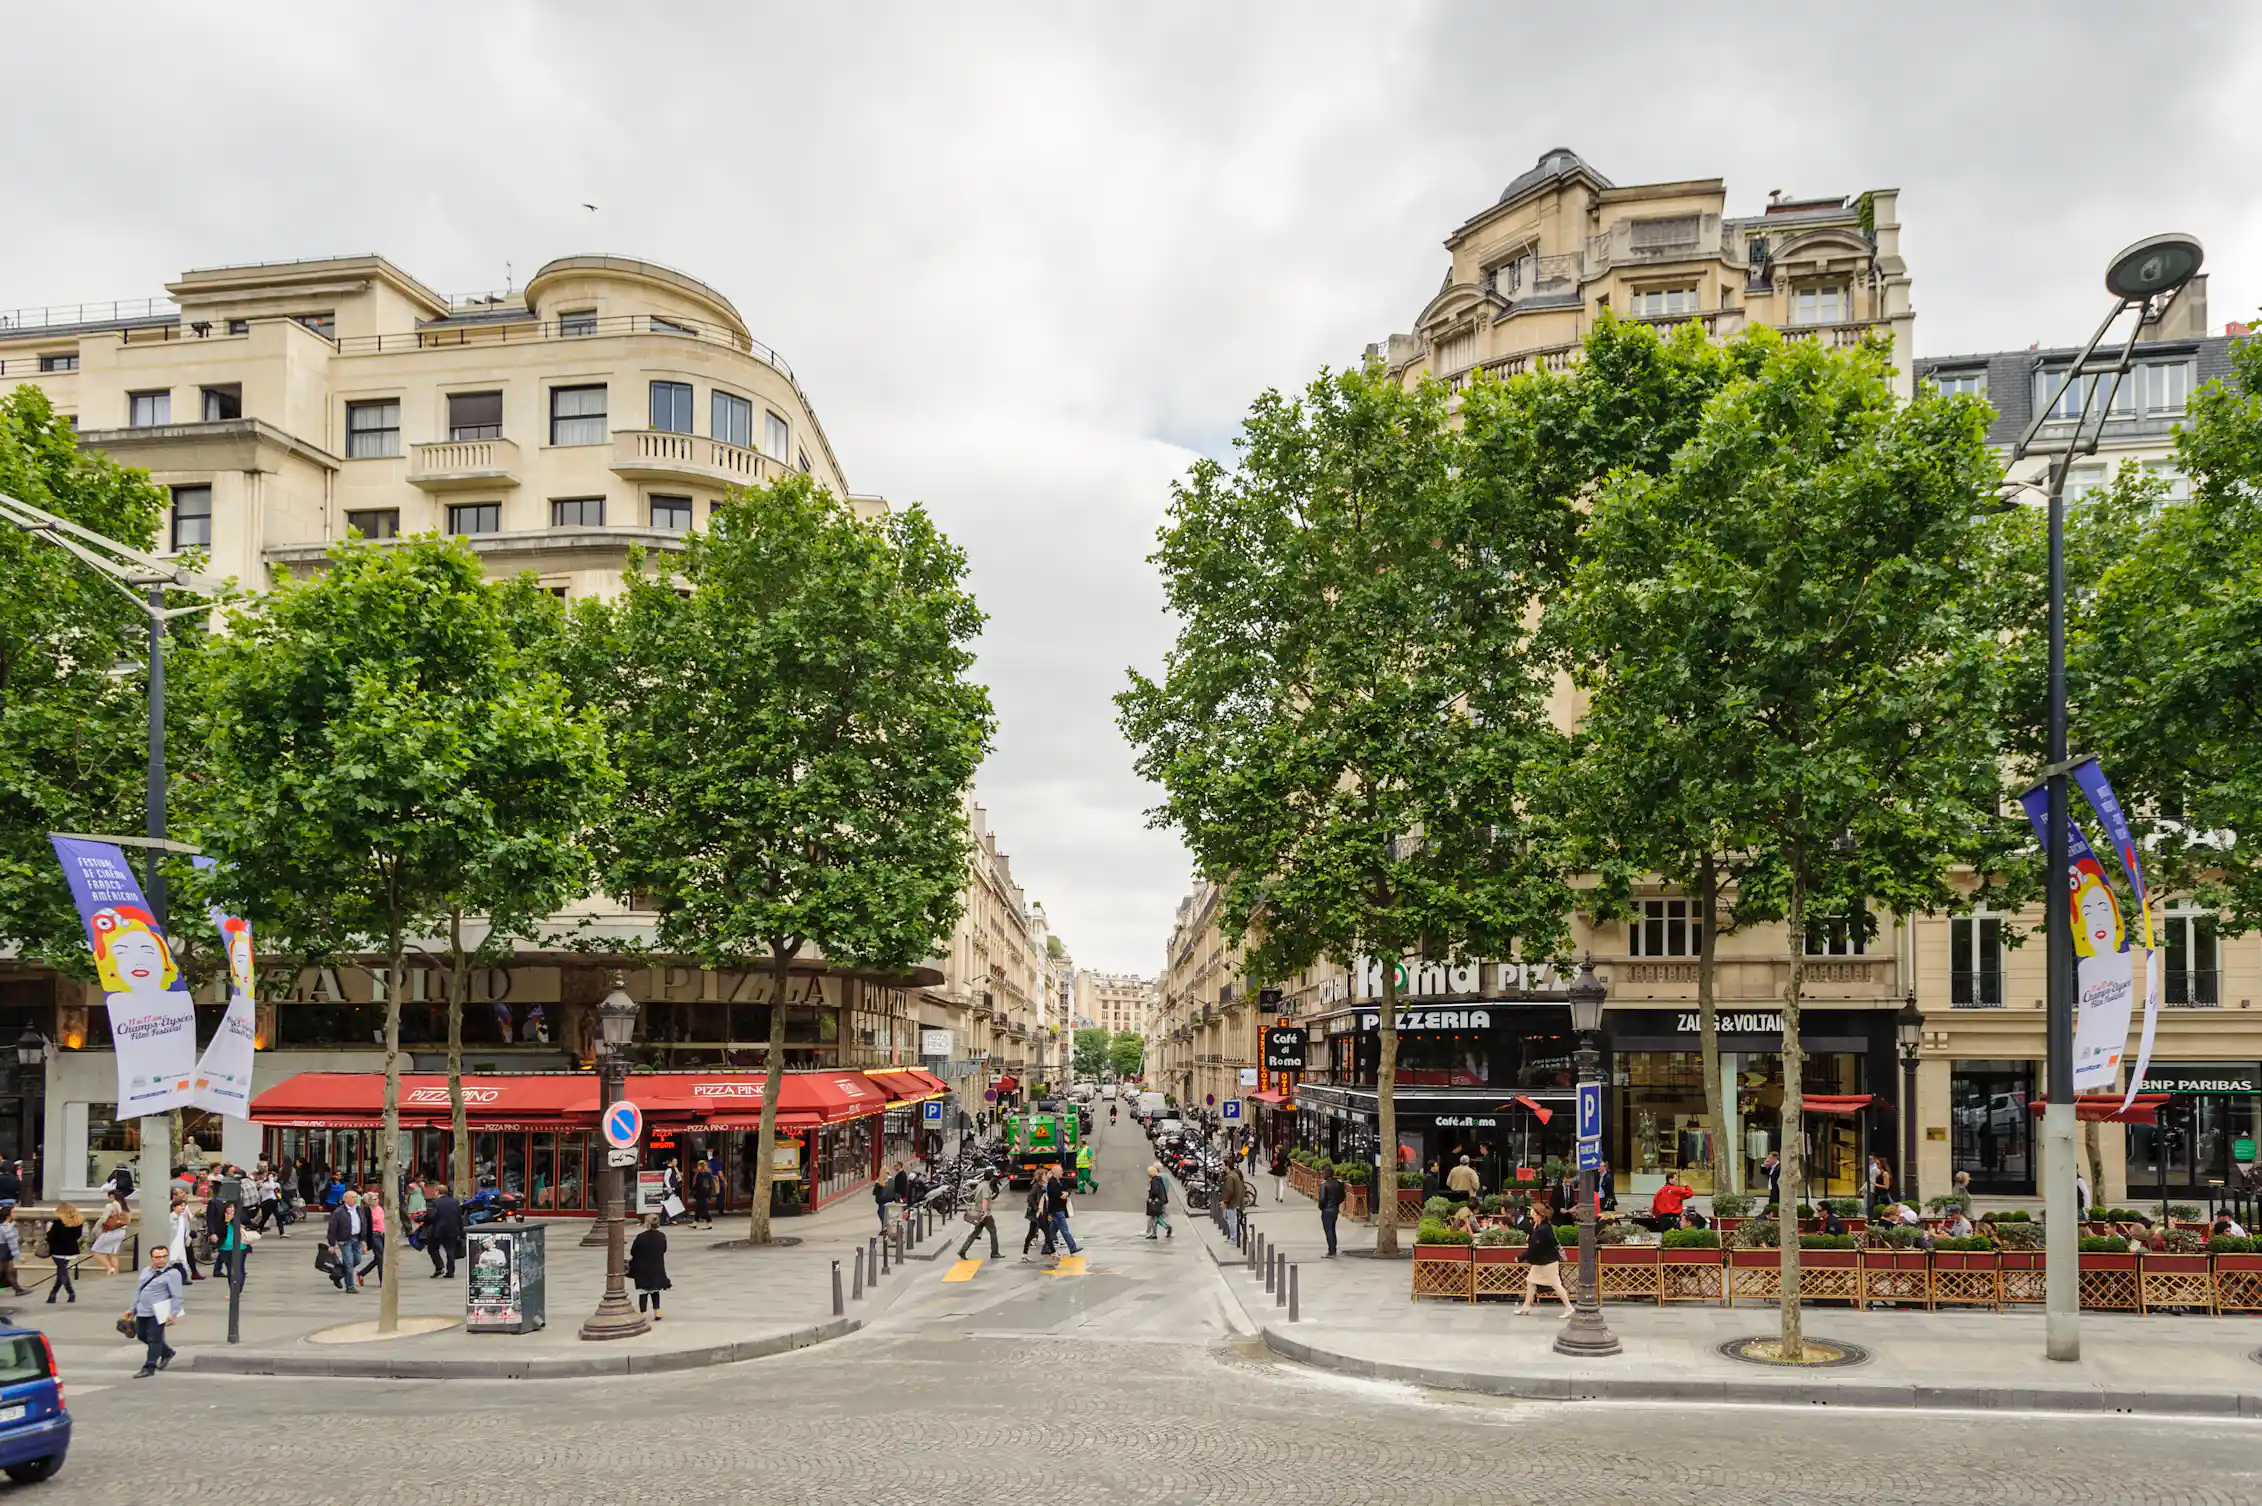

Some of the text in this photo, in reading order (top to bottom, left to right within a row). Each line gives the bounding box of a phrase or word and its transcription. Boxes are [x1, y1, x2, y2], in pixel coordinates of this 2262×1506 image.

[1362, 1010, 1491, 1030] PZZERIA
[1272, 1033, 1298, 1044] Café
[1281, 1046, 1290, 1054] di
[1268, 1055, 1302, 1066] Roma
[694, 1086, 735, 1095] PIZZA
[2139, 1080, 2253, 1090] BNP PARIBAS
[928, 1105, 938, 1117] P
[1227, 1103, 1236, 1117] P
[1584, 1093, 1595, 1130] P
[484, 1123, 503, 1131] PIZZA
[1435, 1116, 1459, 1126] Café
[1465, 1116, 1496, 1127] Roma
[687, 1124, 710, 1132] PIZZA
[711, 1124, 729, 1132] PINO
